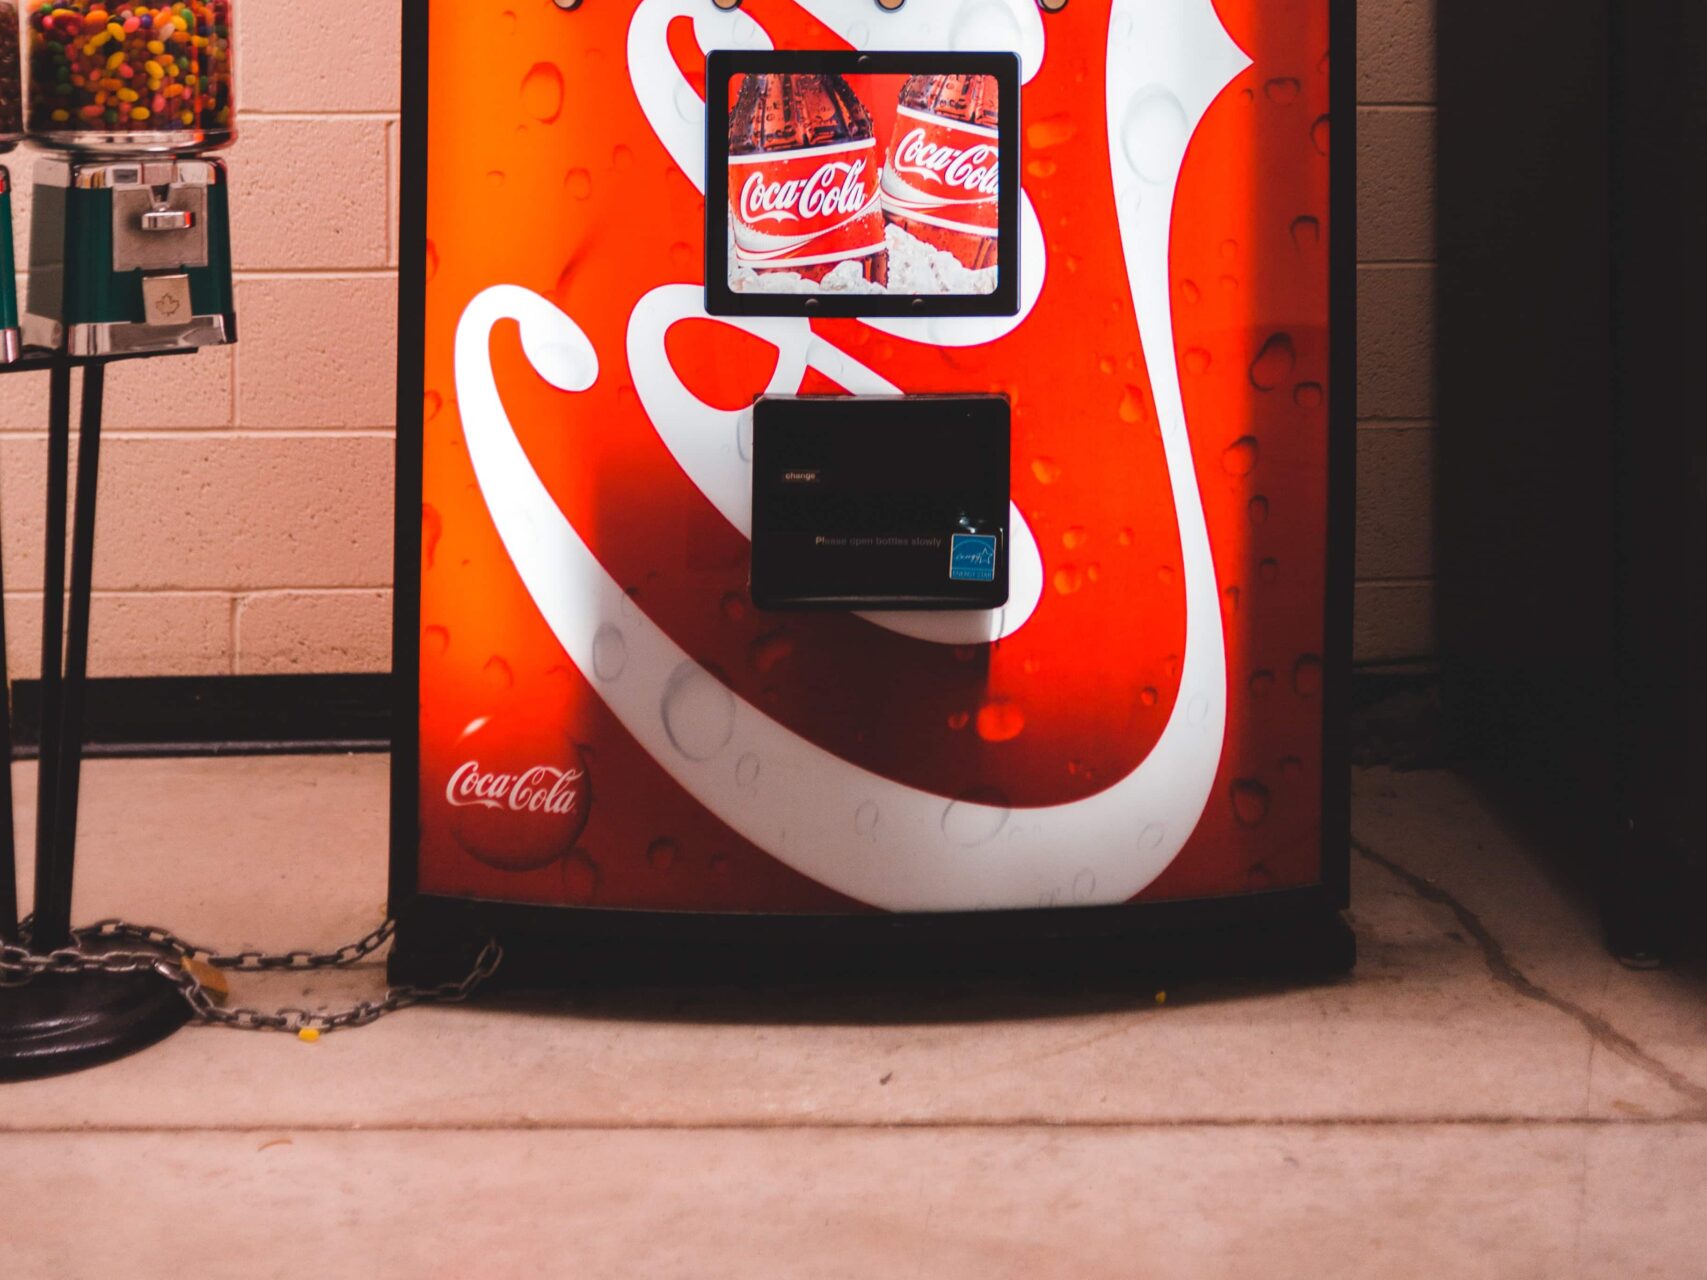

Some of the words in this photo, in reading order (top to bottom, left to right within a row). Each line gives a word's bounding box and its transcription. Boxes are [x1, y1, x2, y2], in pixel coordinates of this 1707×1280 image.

[741, 157, 867, 223] Coca-Cola
[785, 472, 816, 481] change
[446, 760, 584, 814] Coca-Cola
